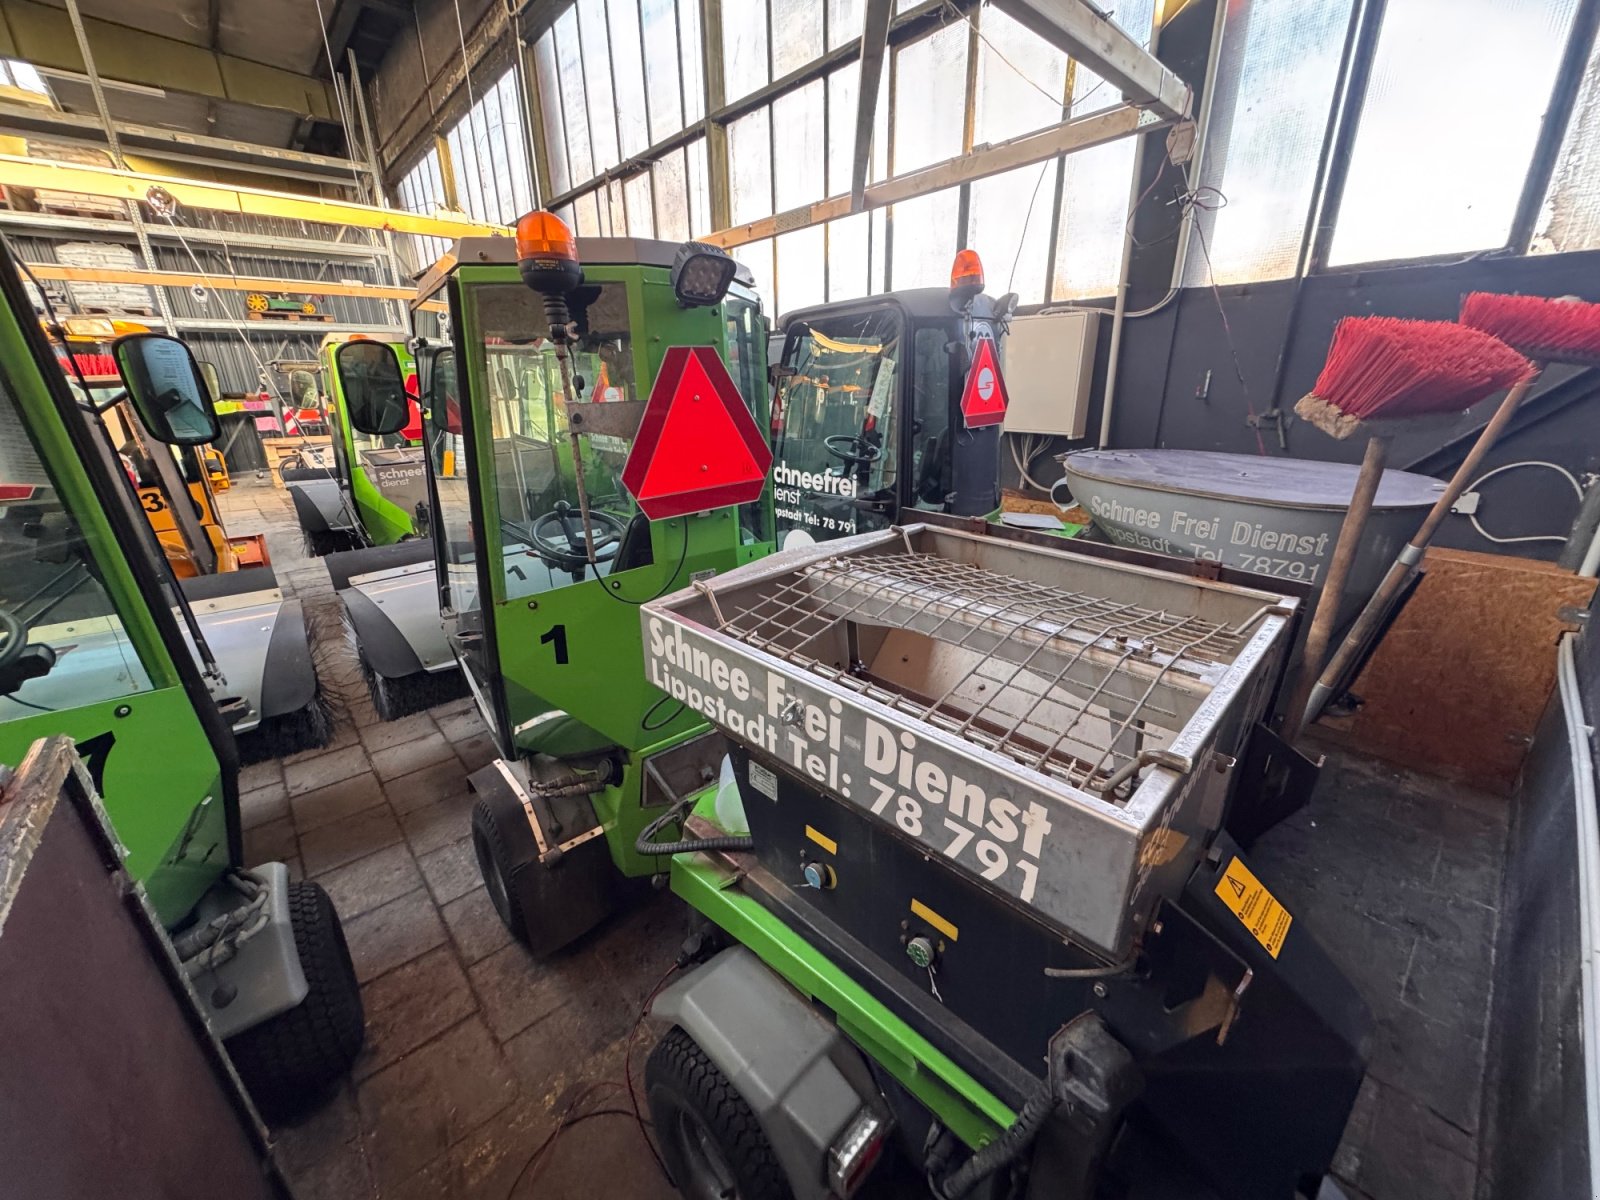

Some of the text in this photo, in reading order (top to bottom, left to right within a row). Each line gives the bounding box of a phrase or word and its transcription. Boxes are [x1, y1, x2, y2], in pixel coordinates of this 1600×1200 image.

[381, 479, 409, 487] dienst
[773, 460, 857, 498] chneefrei
[774, 484, 801, 505] ienst
[141, 493, 164, 512] 3
[803, 512, 820, 526] Tel:
[822, 517, 835, 529] 78
[837, 520, 856, 534] 791
[1091, 495, 1329, 556] Schnee Frei Dienst
[1239, 553, 1320, 582] 78791
[540, 625, 568, 664] 1
[649, 617, 750, 701] Schnee
[864, 718, 1052, 859] Dienst
[74, 730, 116, 799] 7
[651, 658, 778, 754] Lippstadt
[788, 732, 851, 798] Tel:
[869, 777, 923, 837] 78
[943, 817, 1039, 904] 791
